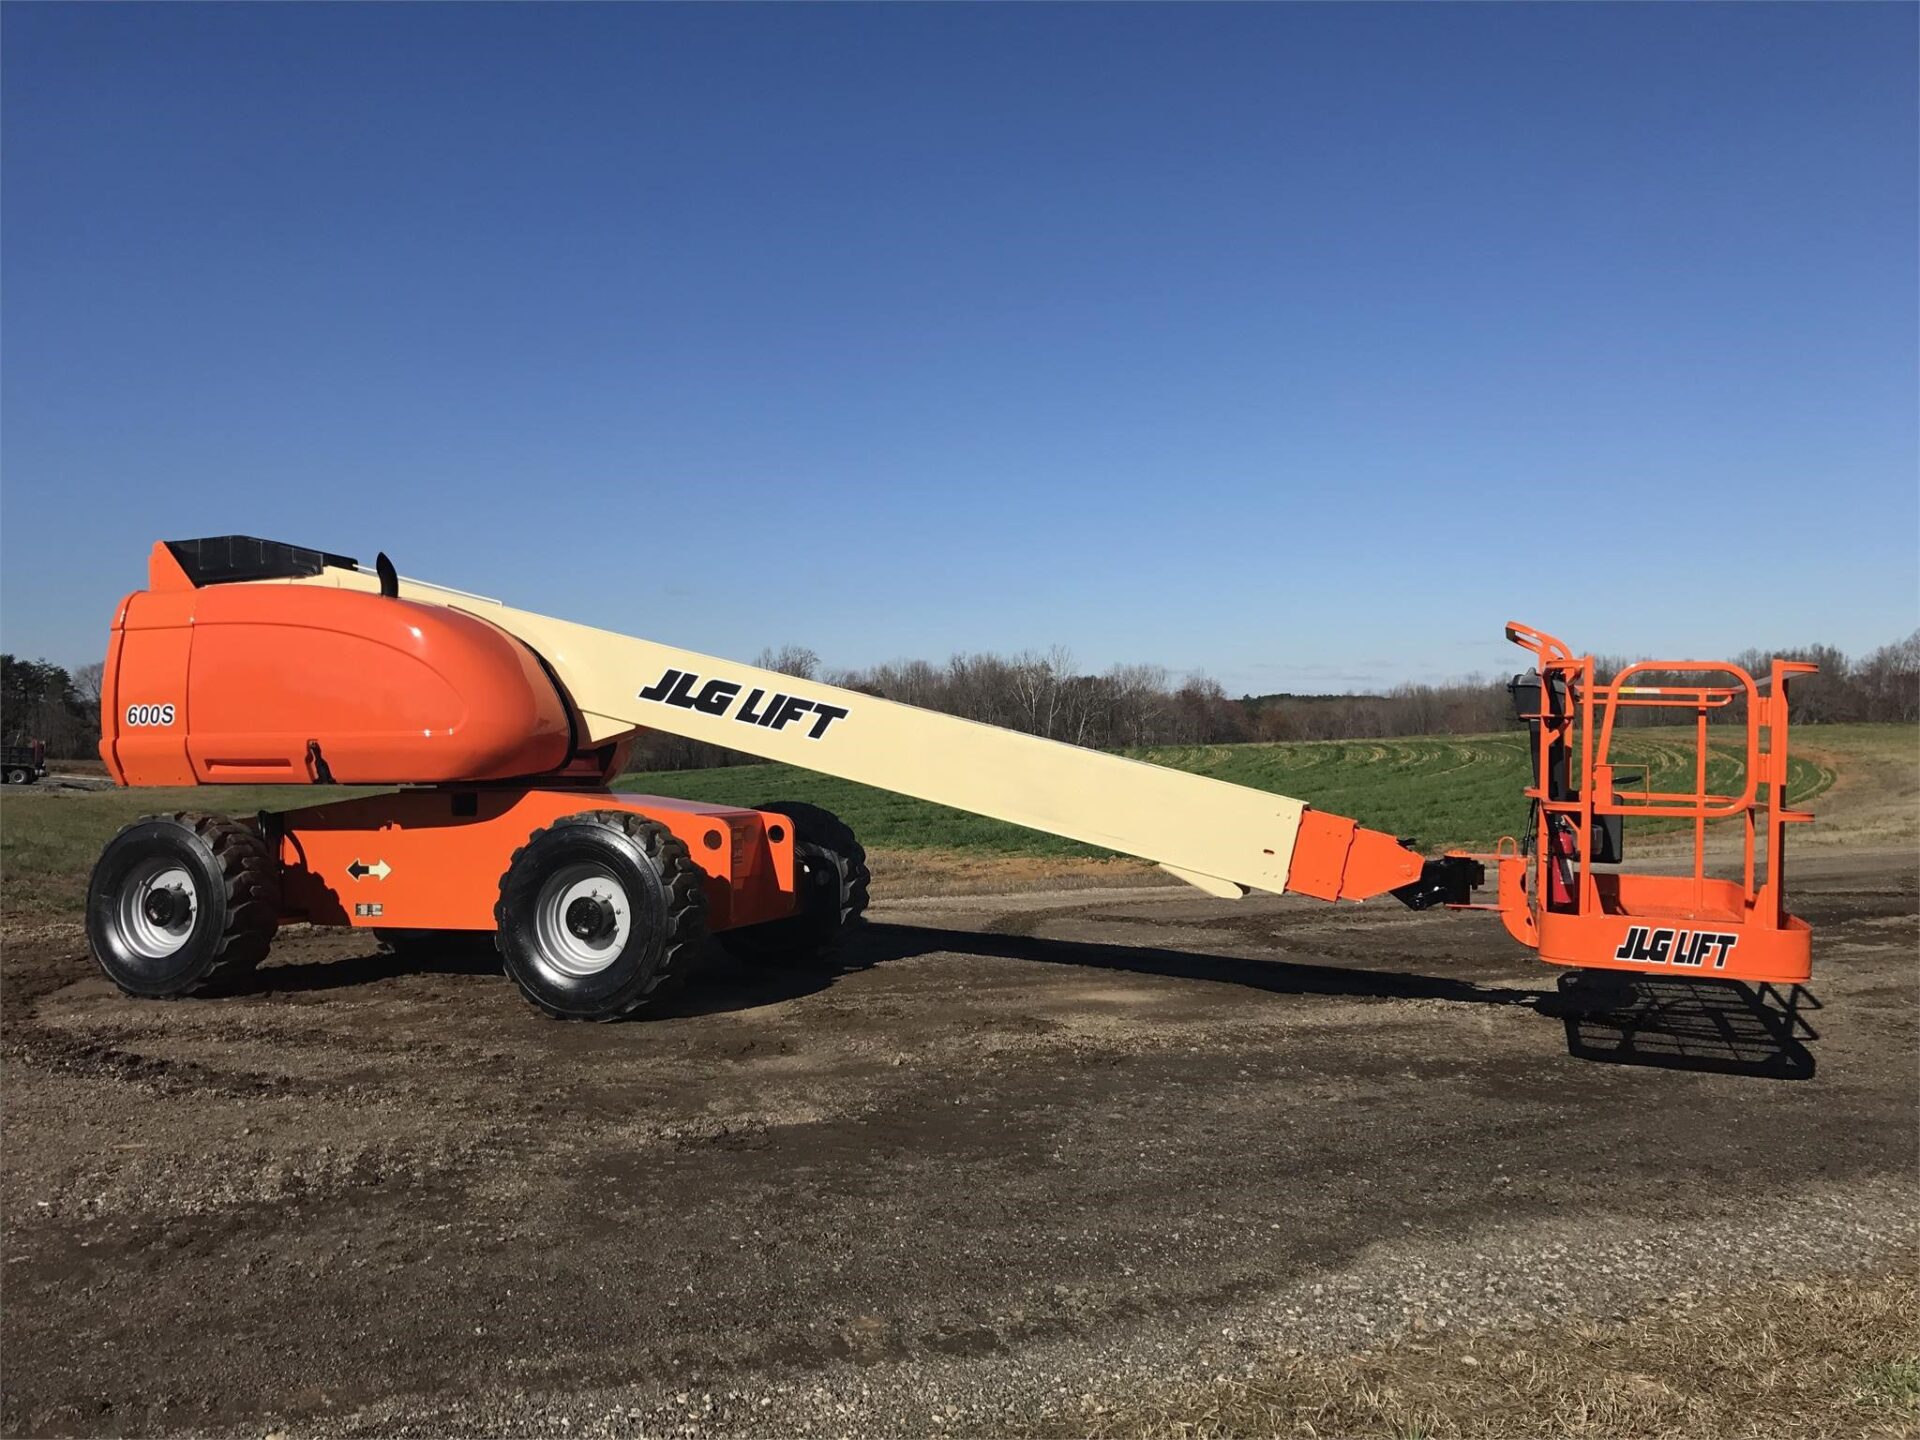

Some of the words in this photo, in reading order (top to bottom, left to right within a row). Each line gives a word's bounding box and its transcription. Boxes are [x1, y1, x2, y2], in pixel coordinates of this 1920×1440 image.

[127, 705, 175, 725] 600S
[638, 668, 743, 717] JLG
[734, 688, 849, 739] LIFT
[1615, 927, 1675, 963] JLG
[1672, 931, 1738, 968] LIFT
